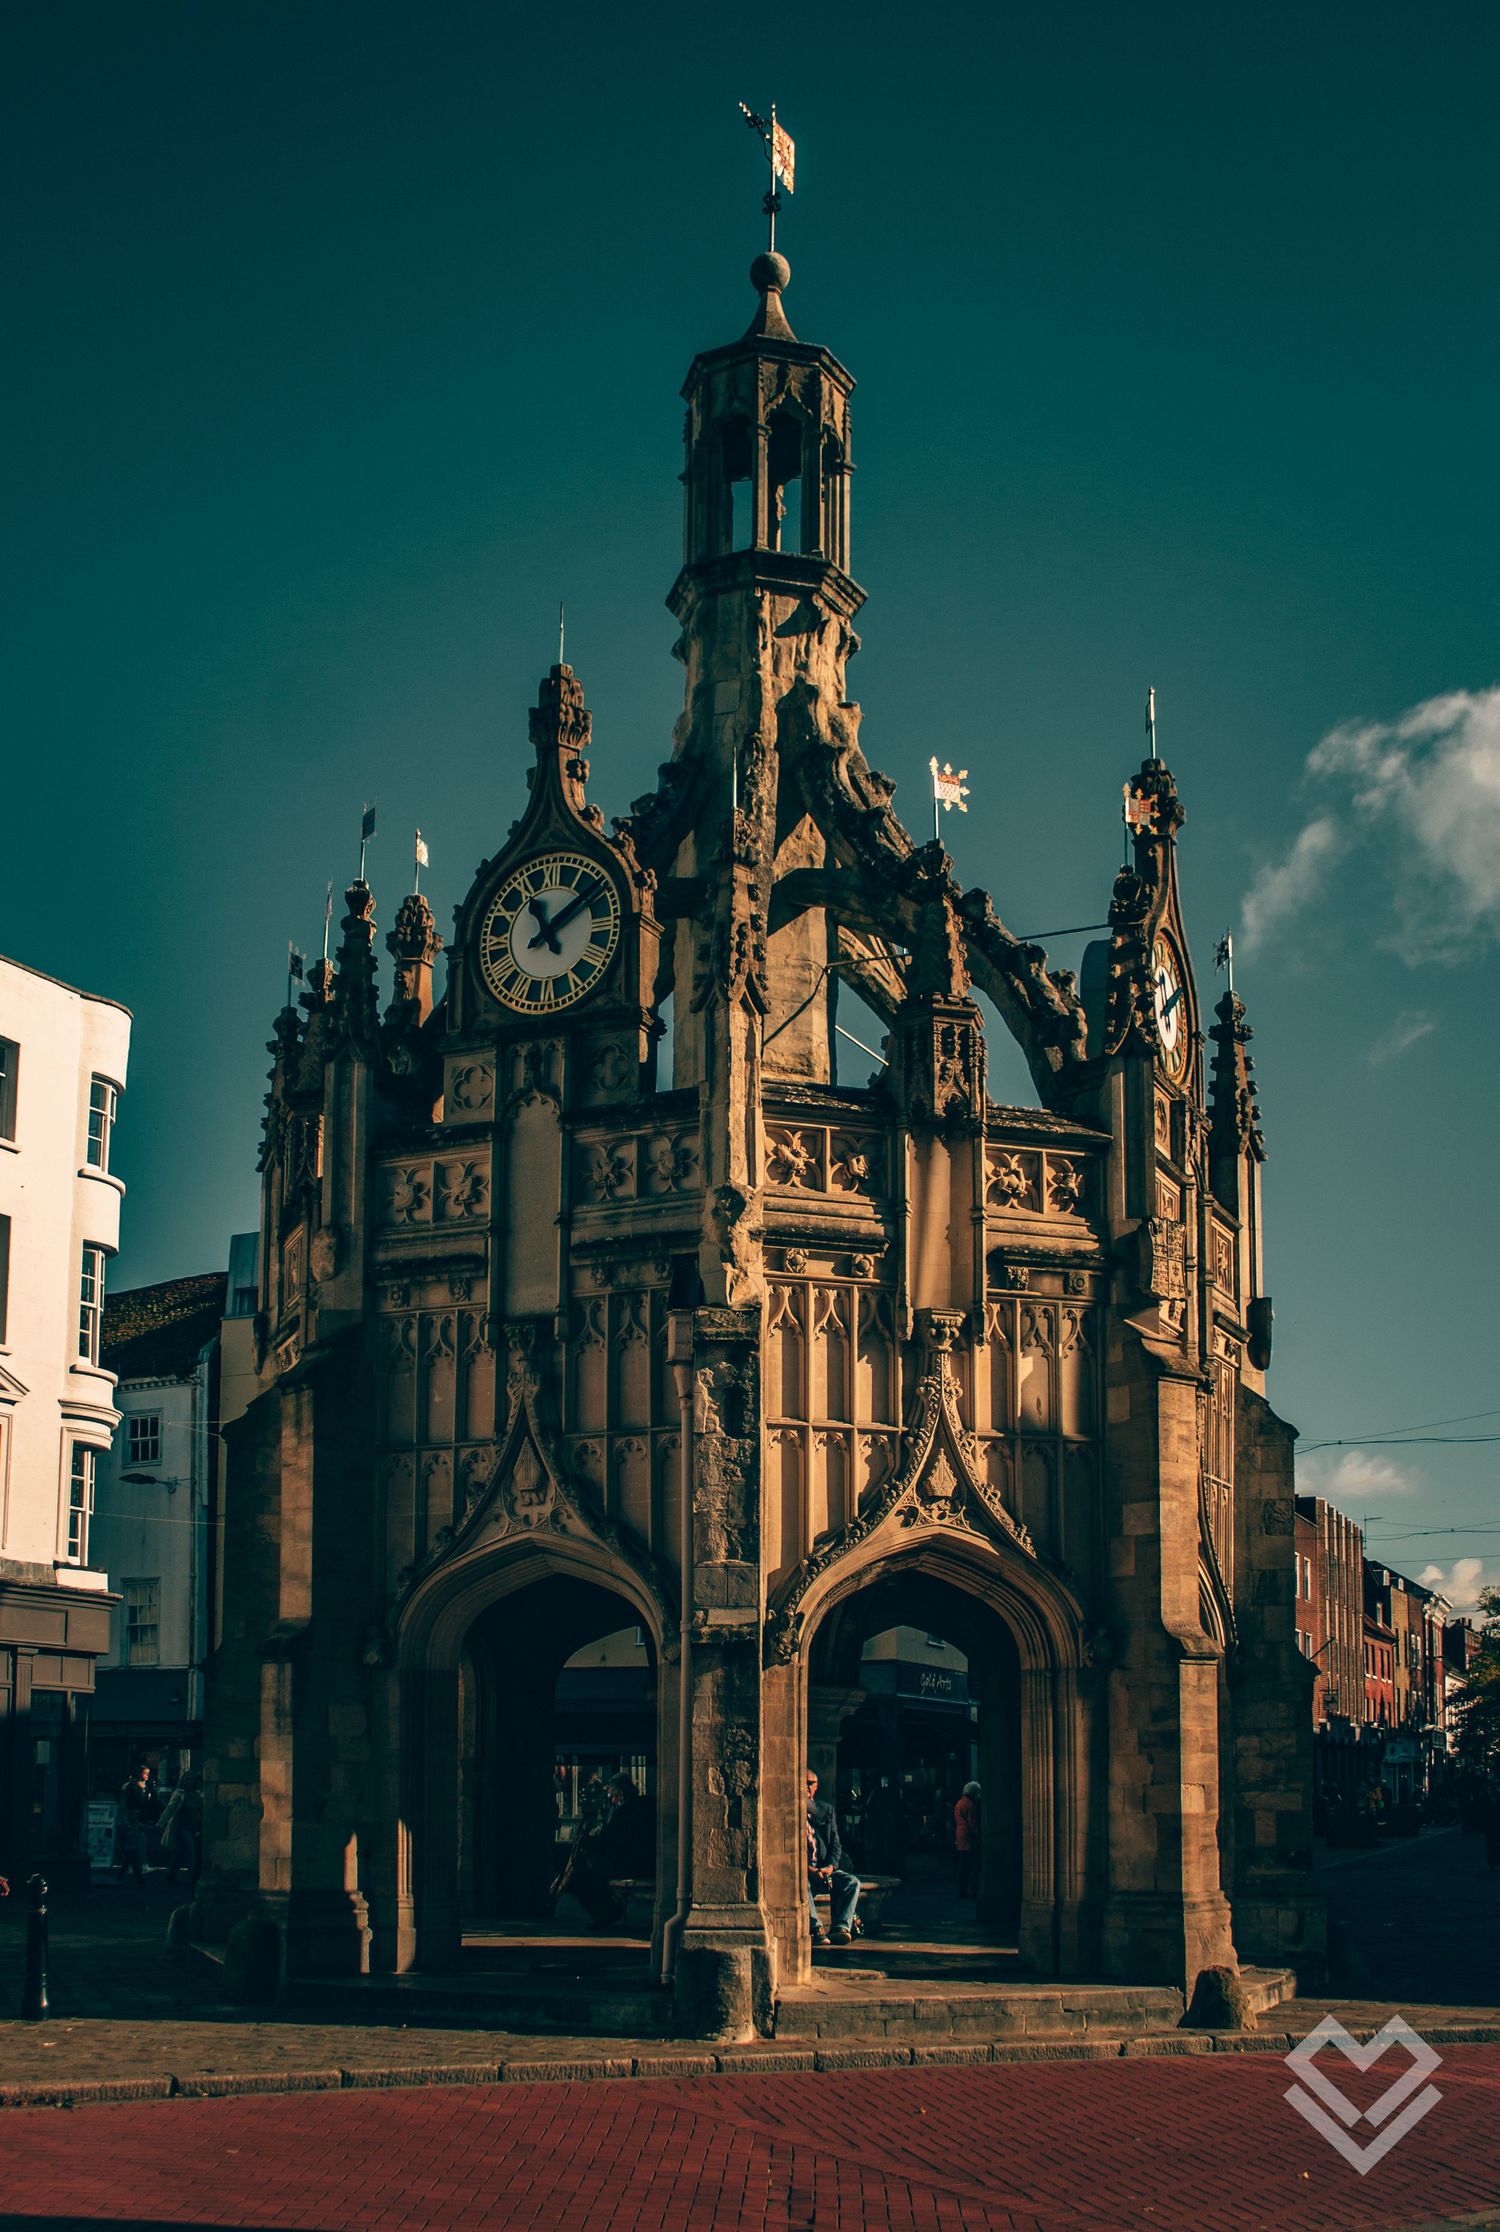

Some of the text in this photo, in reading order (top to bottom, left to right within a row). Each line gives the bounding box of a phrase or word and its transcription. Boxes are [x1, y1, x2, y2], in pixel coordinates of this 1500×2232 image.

[570, 867, 583, 890] I
[494, 904, 515, 923] X
[592, 916, 612, 932] III
[567, 968, 585, 992] V
[920, 1672, 952, 1695] Gold Arts
